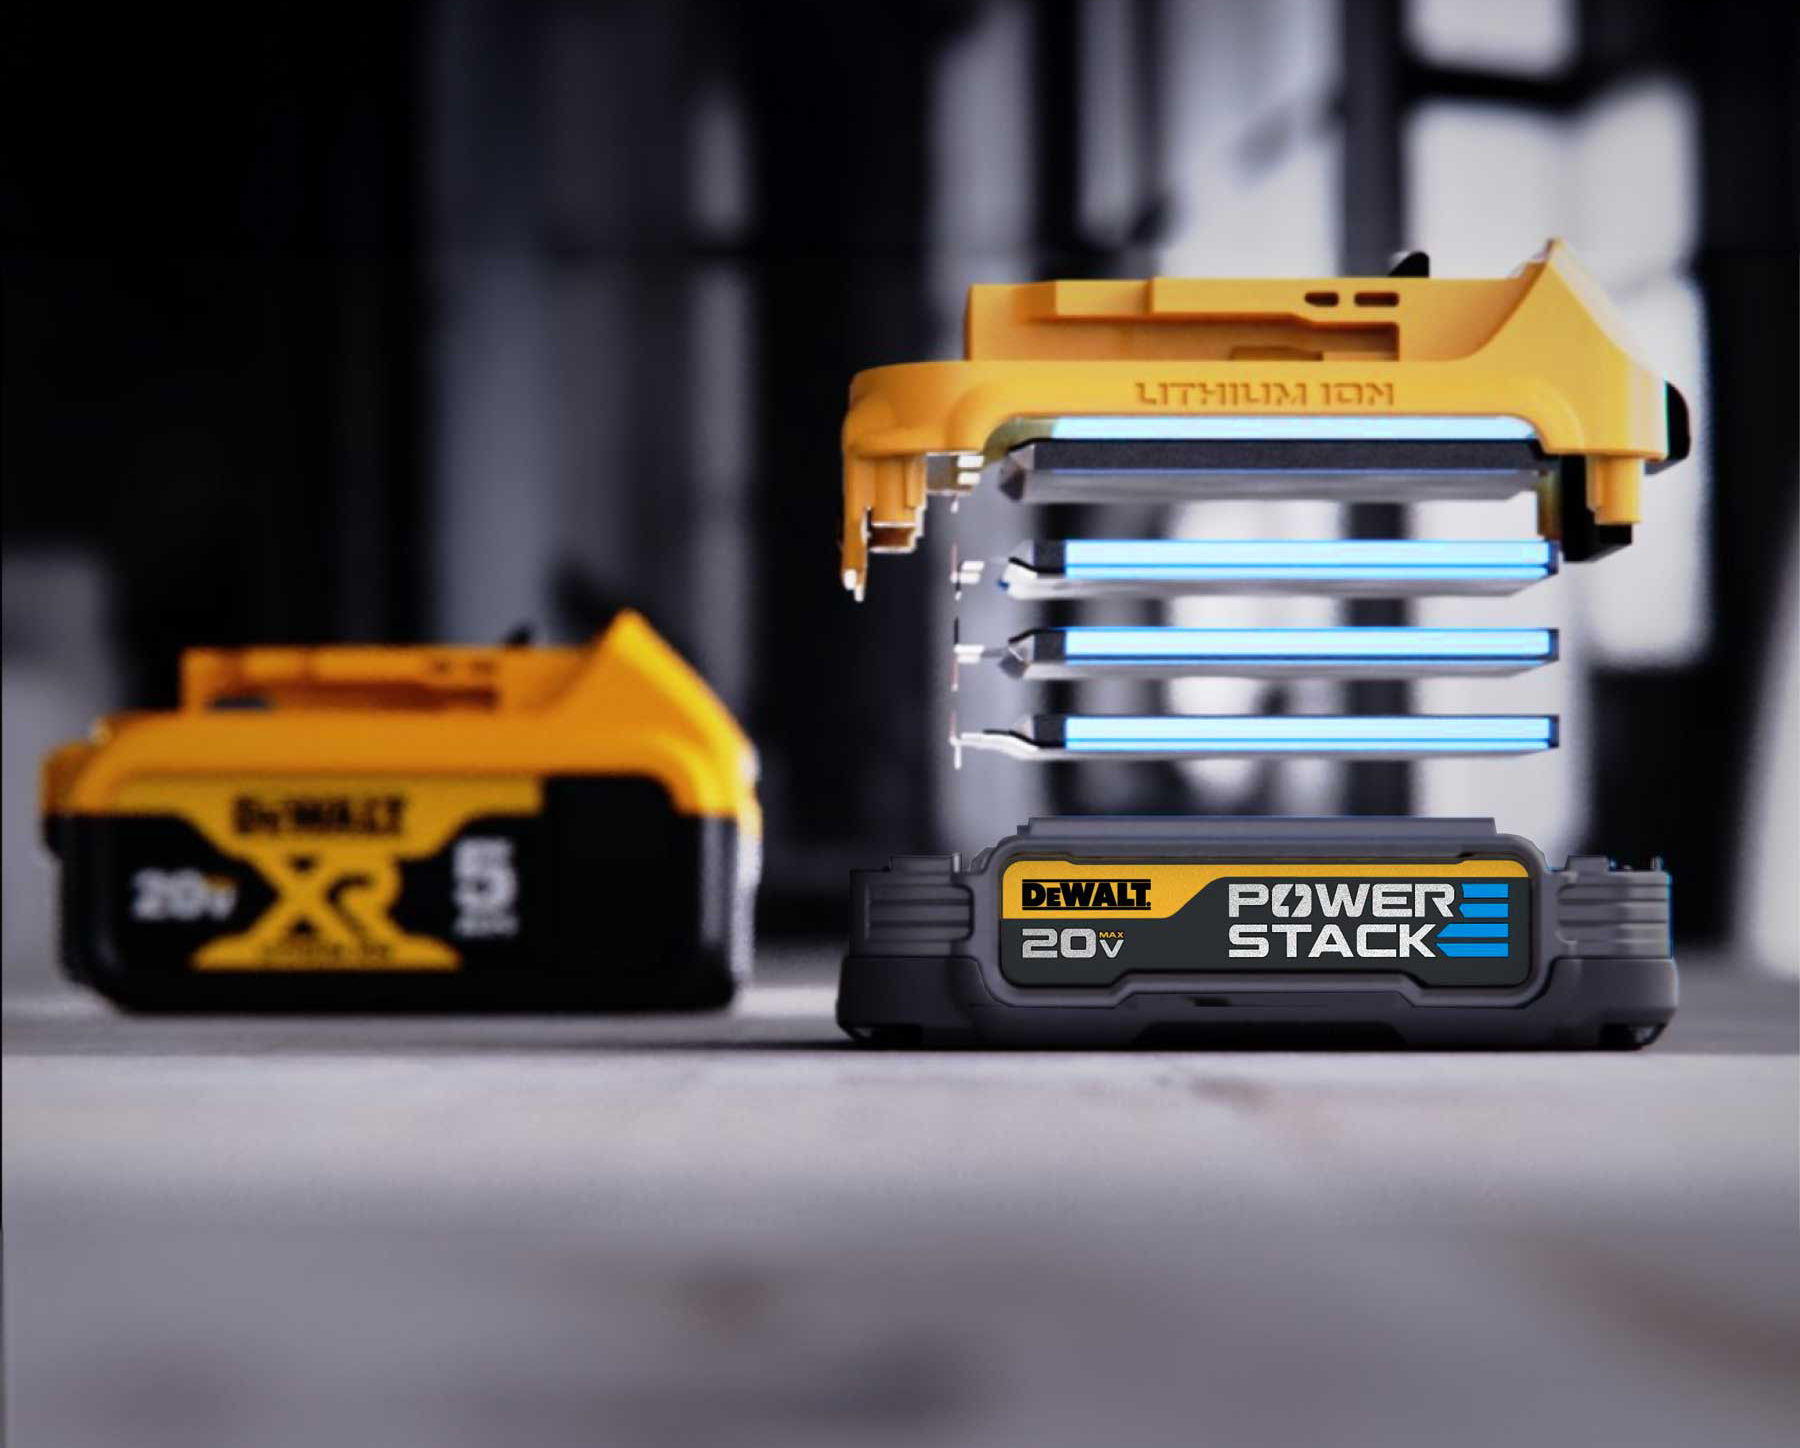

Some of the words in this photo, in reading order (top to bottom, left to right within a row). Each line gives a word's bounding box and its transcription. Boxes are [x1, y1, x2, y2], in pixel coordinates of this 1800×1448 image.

[1135, 382, 1308, 406] LITHIUM
[1320, 382, 1395, 406] ION
[453, 836, 519, 902] 5
[1228, 883, 1456, 918] POWER
[1099, 930, 1125, 939] MAX
[1228, 924, 1437, 958] STACK
